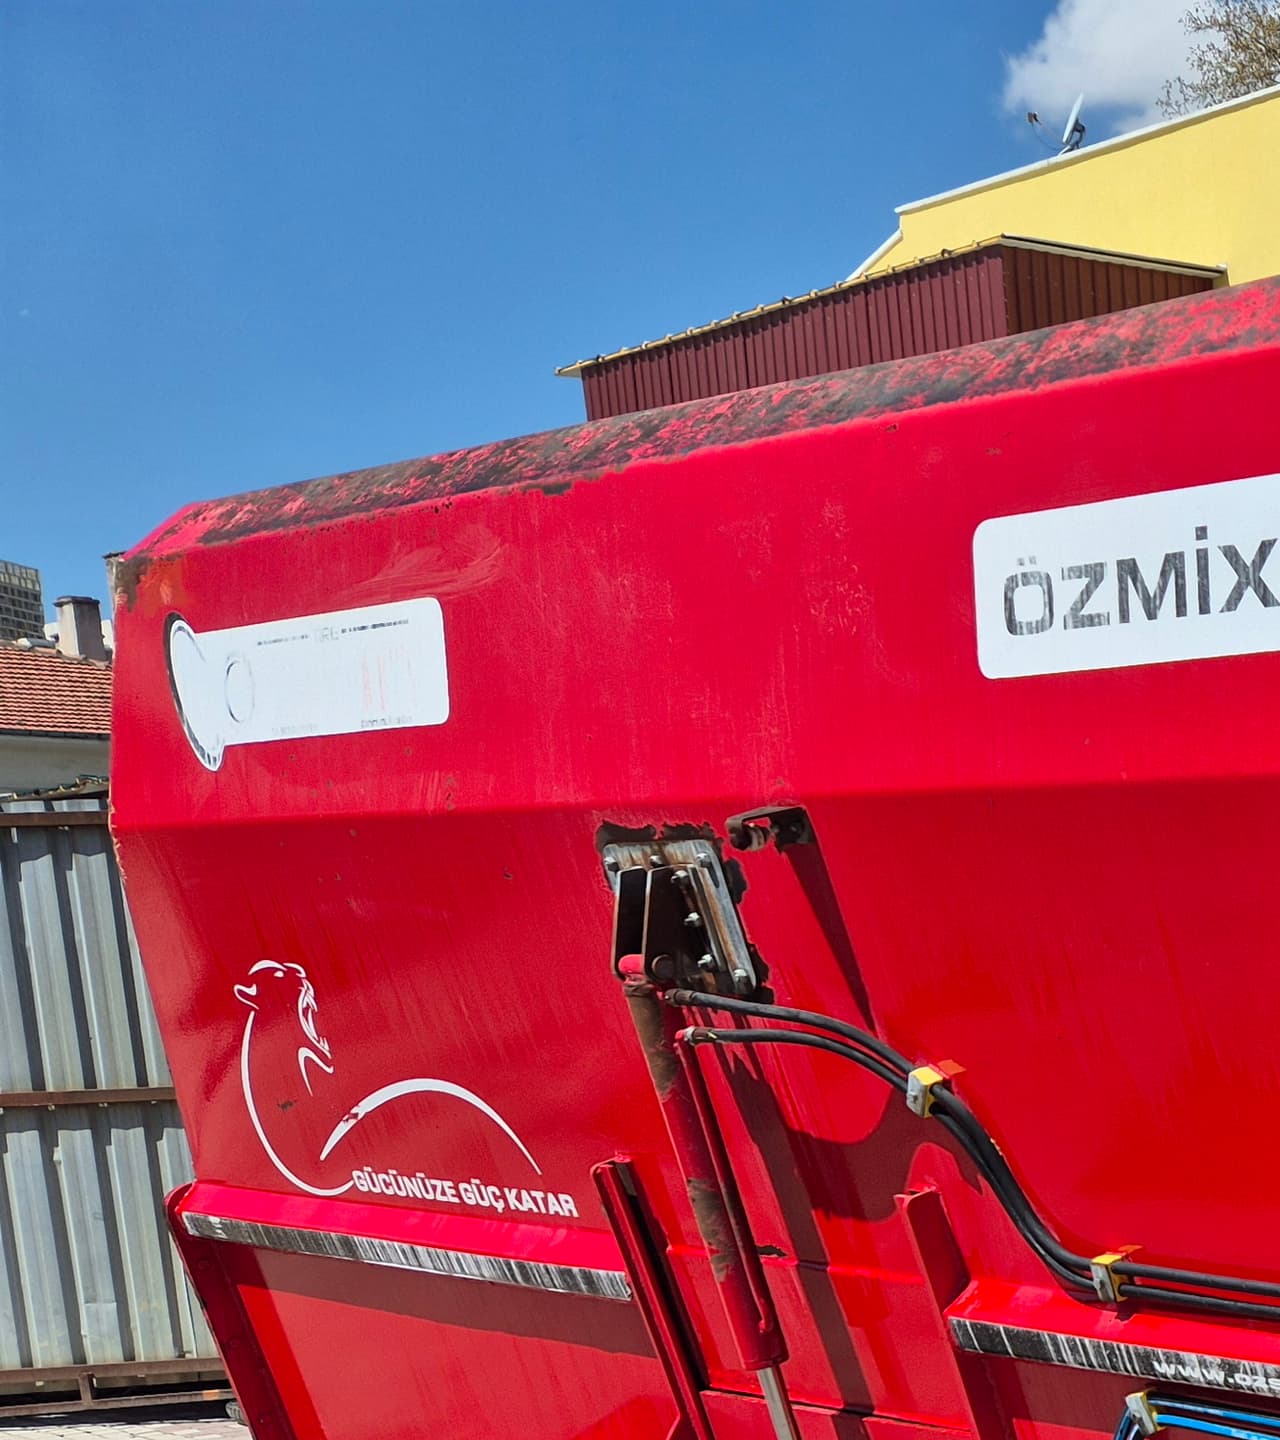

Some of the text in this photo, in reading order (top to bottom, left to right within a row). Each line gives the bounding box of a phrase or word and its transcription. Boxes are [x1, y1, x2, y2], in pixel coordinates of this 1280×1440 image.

[351, 1166, 580, 1218] GÜCÜNÜZE GÜÇ KATAR
